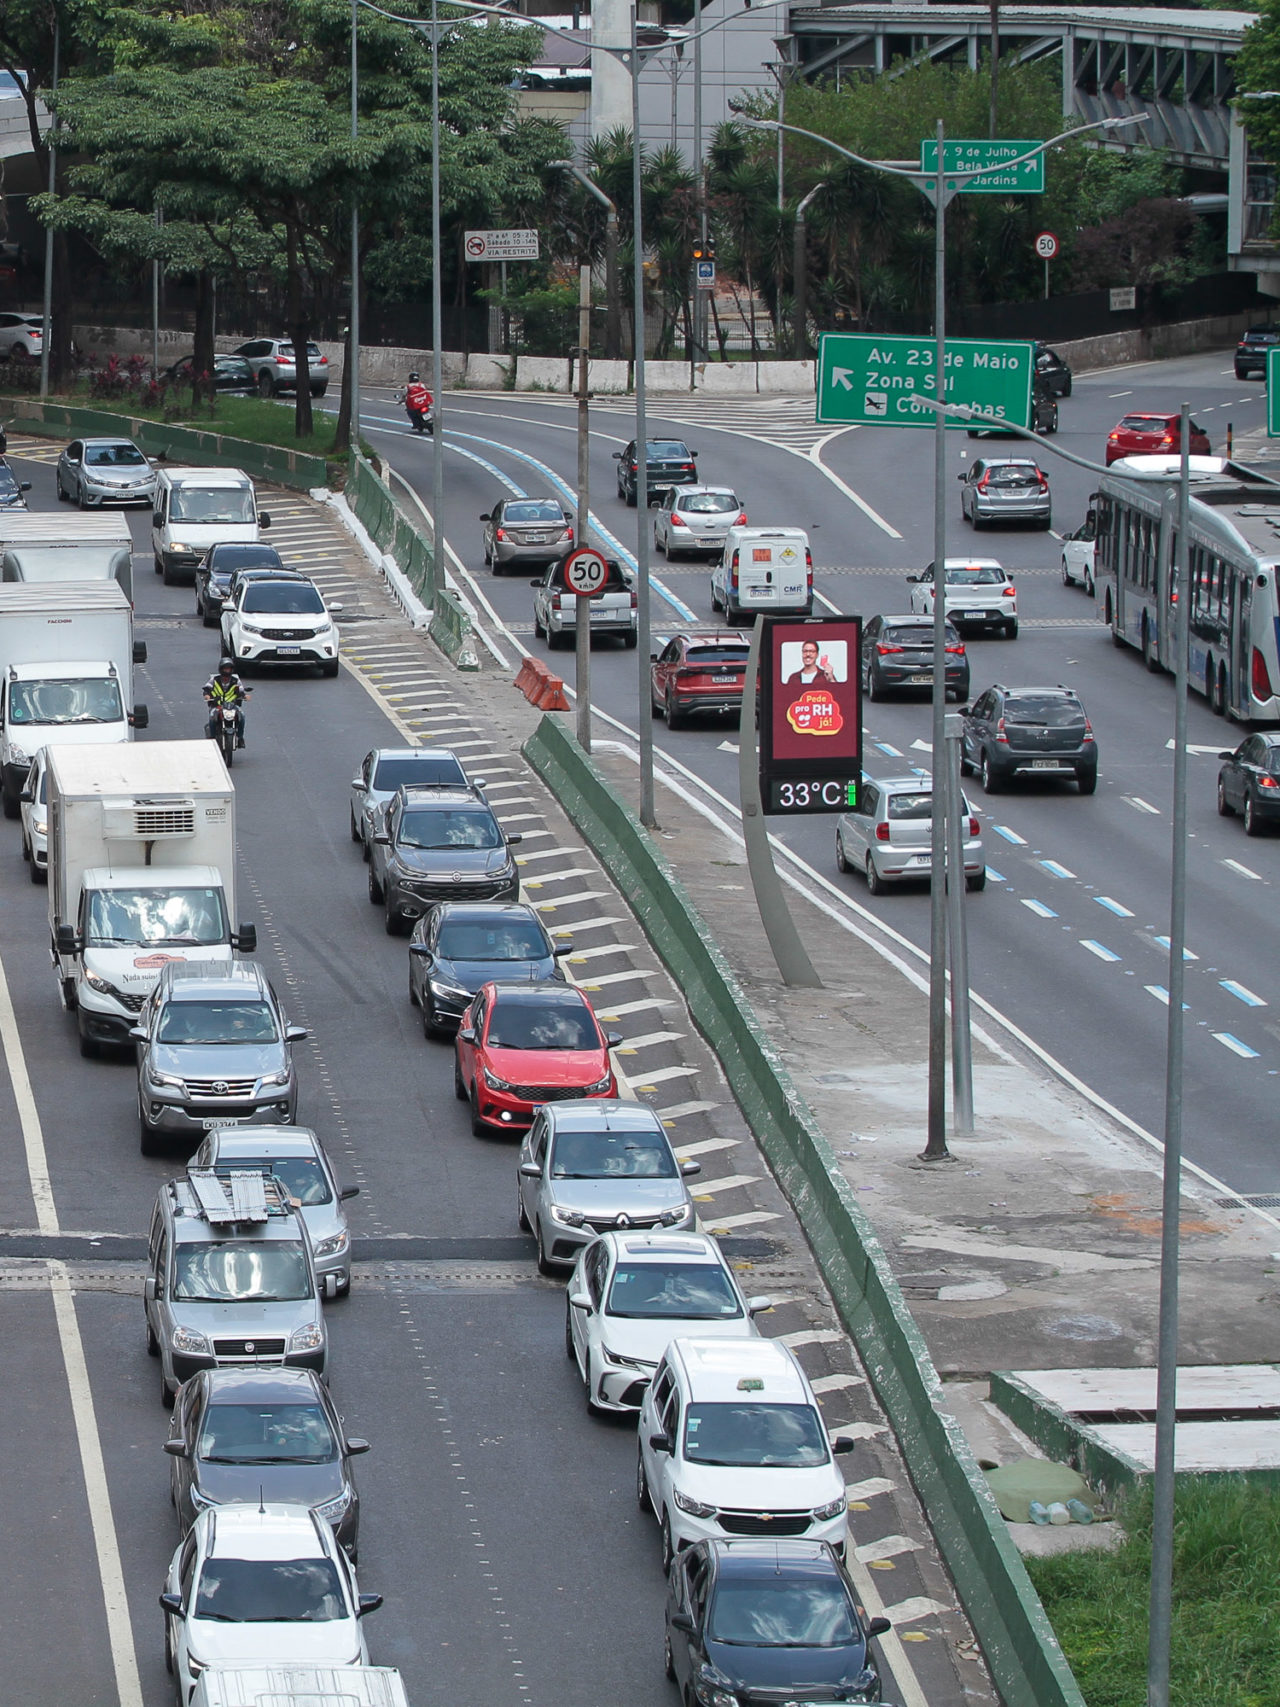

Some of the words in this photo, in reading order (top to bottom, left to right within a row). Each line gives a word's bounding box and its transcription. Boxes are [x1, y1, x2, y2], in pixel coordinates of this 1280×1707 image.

[955, 147, 962, 156] 9
[966, 147, 980, 156] de
[985, 147, 1018, 157] Julho
[956, 161, 983, 171] Bela
[972, 175, 1018, 185] Jardins
[1040, 239, 1054, 250] 50
[867, 348, 896, 365] Av.
[907, 350, 933, 366] 23
[943, 352, 964, 367] de
[973, 352, 1019, 369] Maio
[866, 372, 915, 389] Zona
[573, 560, 601, 581] 50
[806, 695, 827, 703] Pede
[795, 705, 810, 714] pro
[812, 703, 833, 716] RH
[818, 717, 833, 729] já!
[122, 974, 141, 984] Nada
